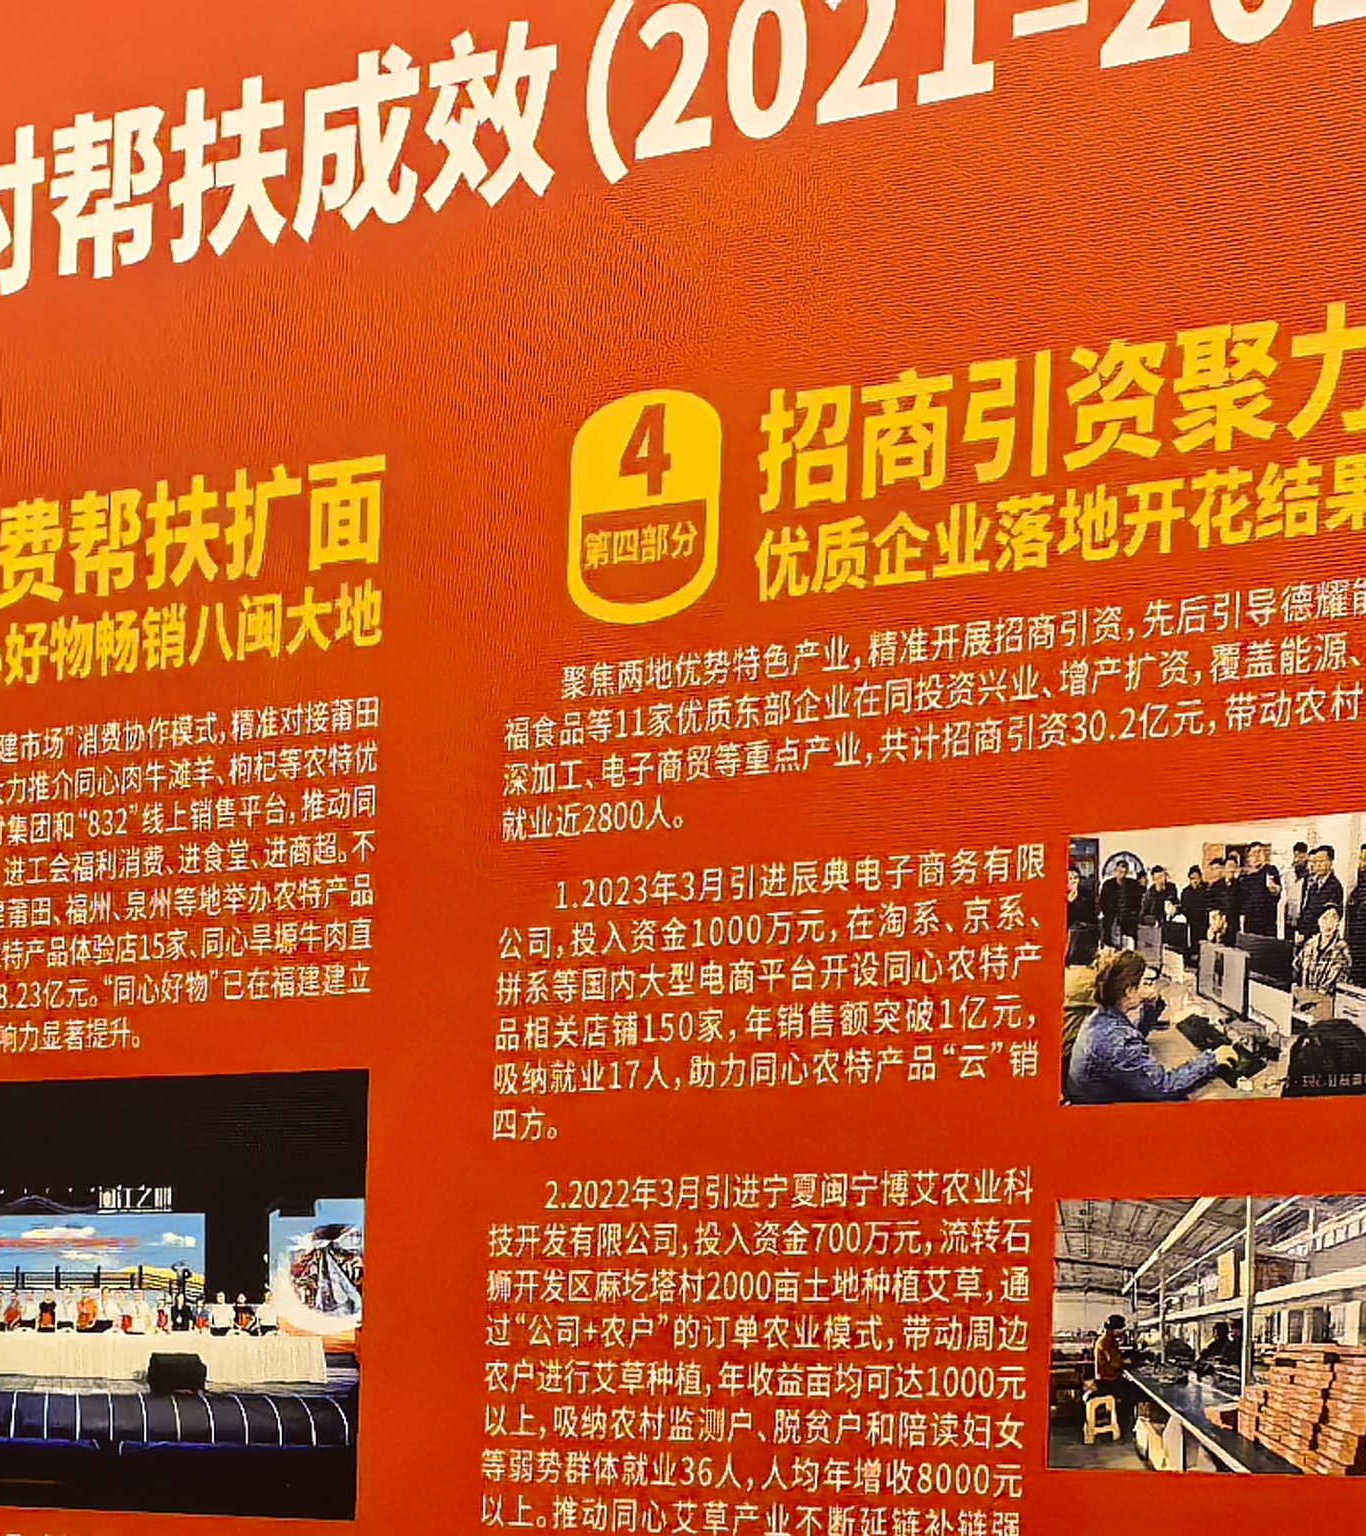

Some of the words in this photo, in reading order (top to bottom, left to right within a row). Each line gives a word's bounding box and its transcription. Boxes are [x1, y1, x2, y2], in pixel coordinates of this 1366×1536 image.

[631, 406, 671, 491] 4
[582, 519, 698, 573] 第四部分
[502, 797, 684, 842] 就业近2800人。
[496, 941, 1043, 1007] 拼系等国内大型电商平台开设同心农特产
[492, 1108, 558, 1142] 四方。
